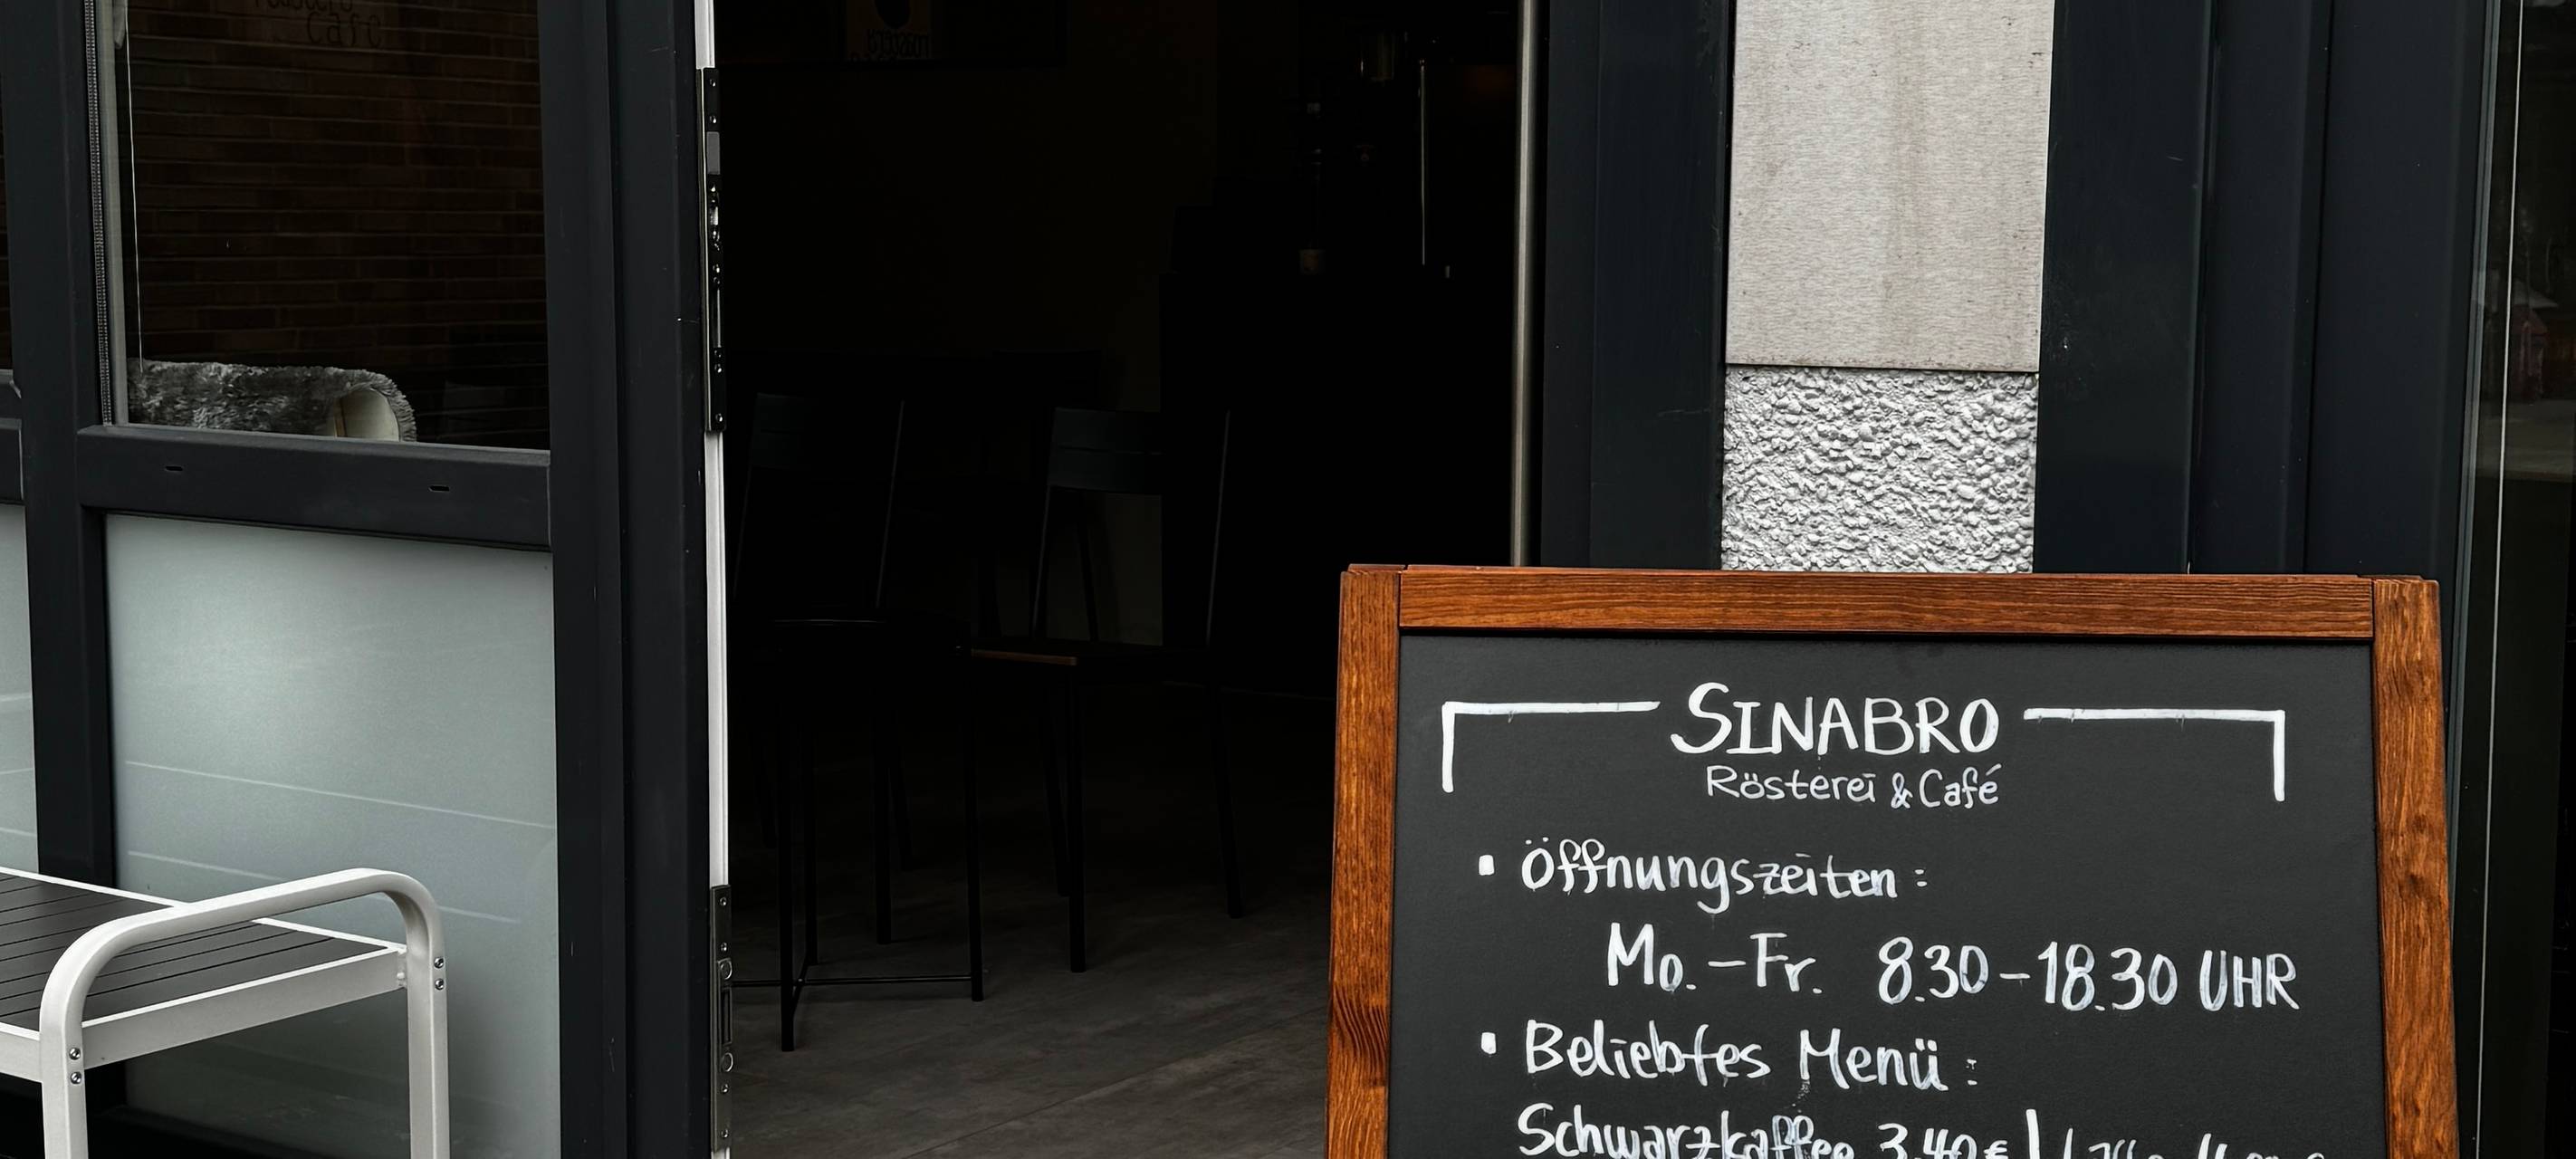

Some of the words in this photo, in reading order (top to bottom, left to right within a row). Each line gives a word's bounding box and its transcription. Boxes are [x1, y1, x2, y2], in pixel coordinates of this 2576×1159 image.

[1670, 682, 1999, 755] SINABRO
[1706, 764, 1876, 803] Rösterei
[1890, 771, 1913, 809] &
[1919, 763, 2002, 809] Café
[2198, 949, 2300, 1011] UHR
[1525, 1019, 1771, 1087] Beliebtes
